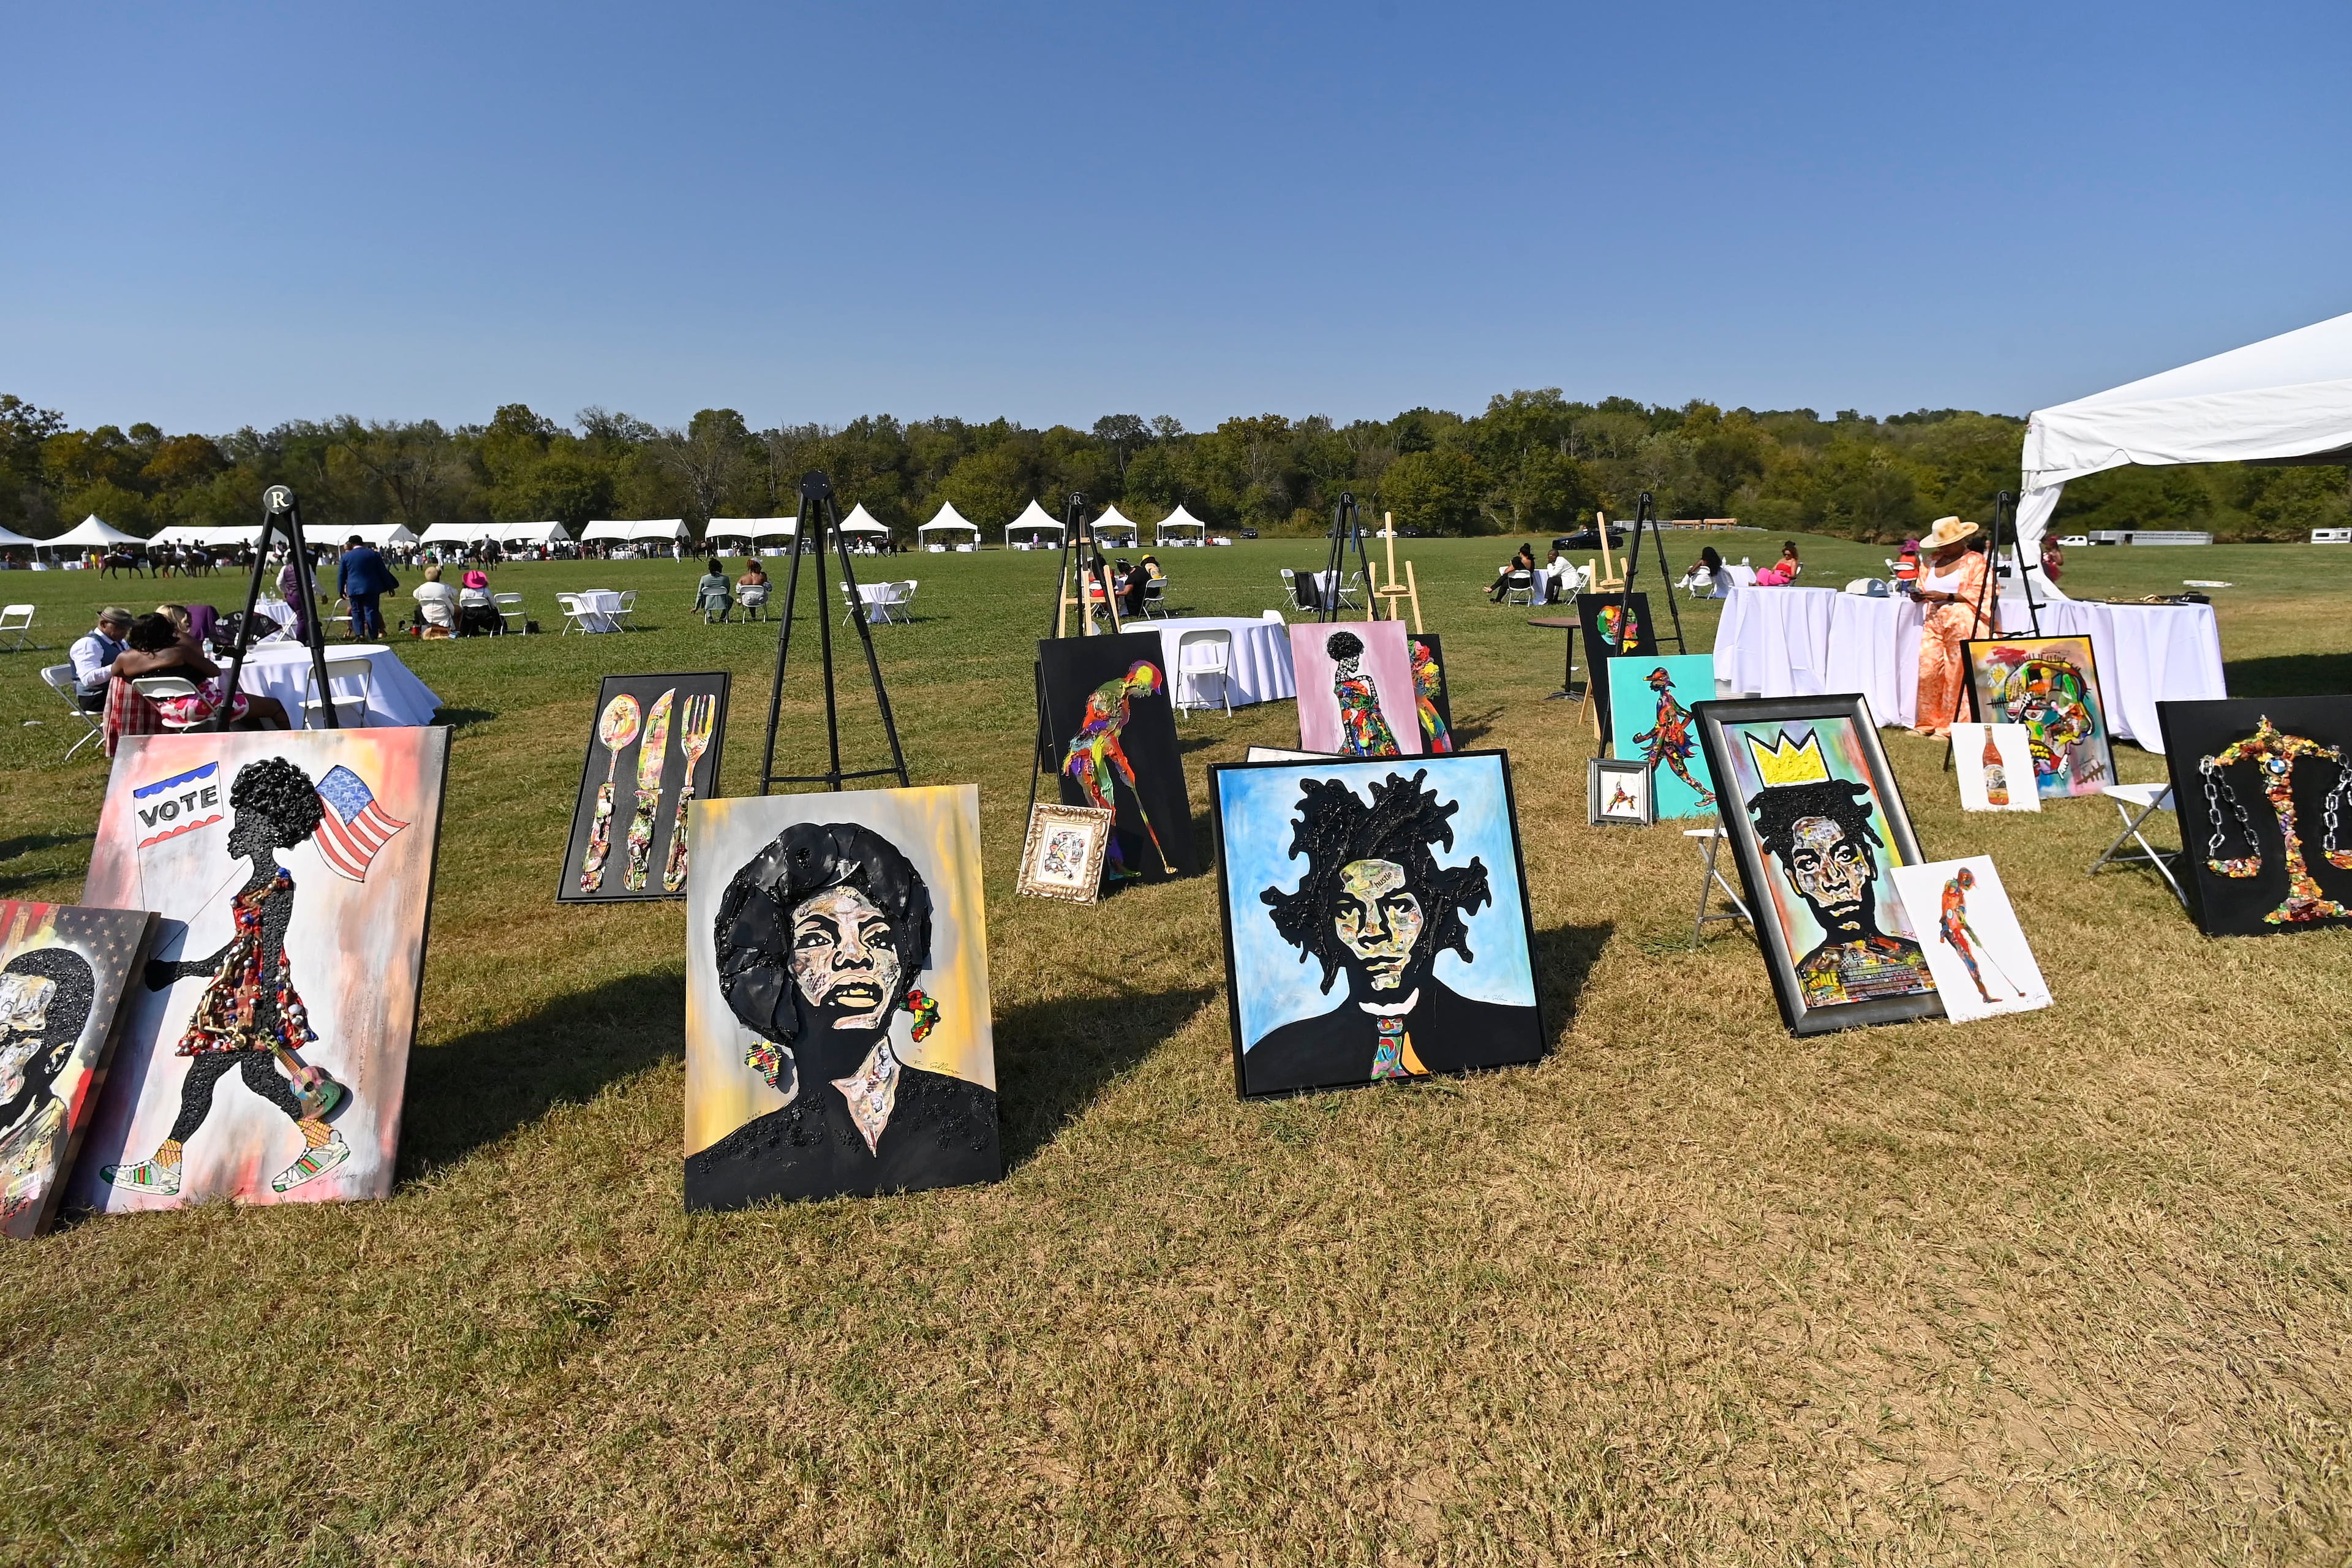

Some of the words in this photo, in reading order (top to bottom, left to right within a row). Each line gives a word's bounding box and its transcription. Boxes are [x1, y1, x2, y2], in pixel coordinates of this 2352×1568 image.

[271, 491, 289, 508] R
[1073, 496, 1084, 505] R
[1344, 494, 1352, 503] R
[1643, 493, 1651, 502] R
[2002, 492, 2008, 501] R
[138, 785, 218, 828] VOTE
[1373, 872, 1392, 889] hustle
